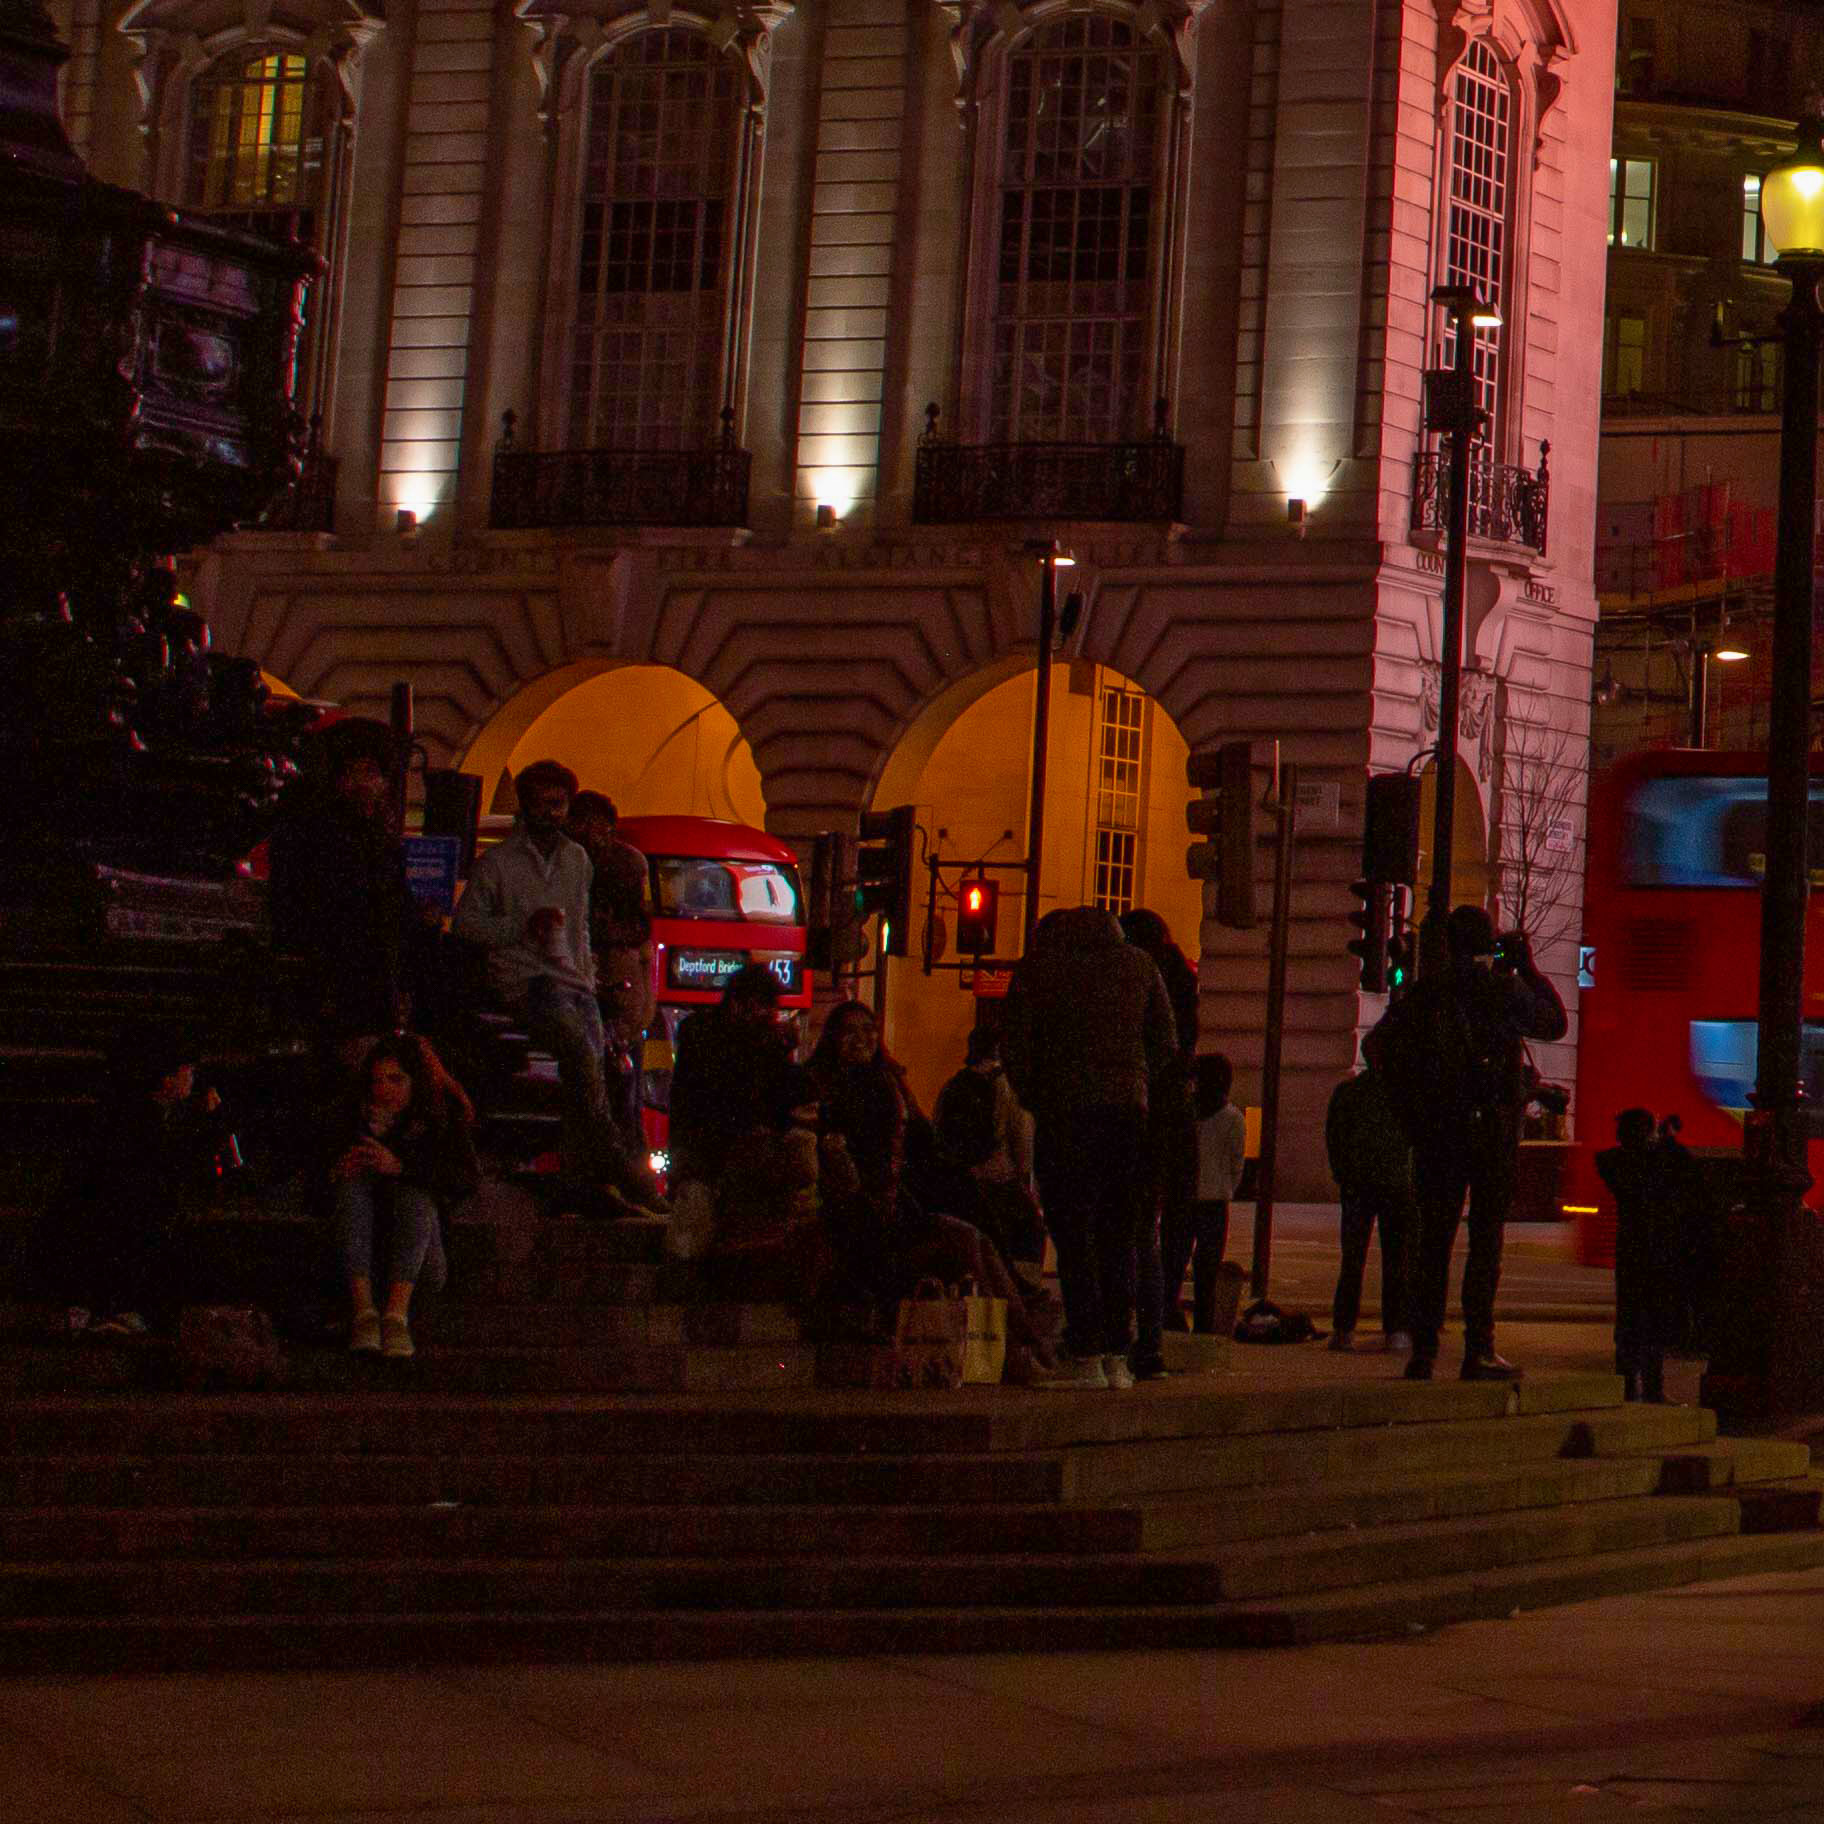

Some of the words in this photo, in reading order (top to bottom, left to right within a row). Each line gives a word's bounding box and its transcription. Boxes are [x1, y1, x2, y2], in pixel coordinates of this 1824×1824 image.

[1416, 552, 1445, 574] COUN
[1524, 579, 1555, 604] OFFICE
[680, 958, 716, 976] Deptford
